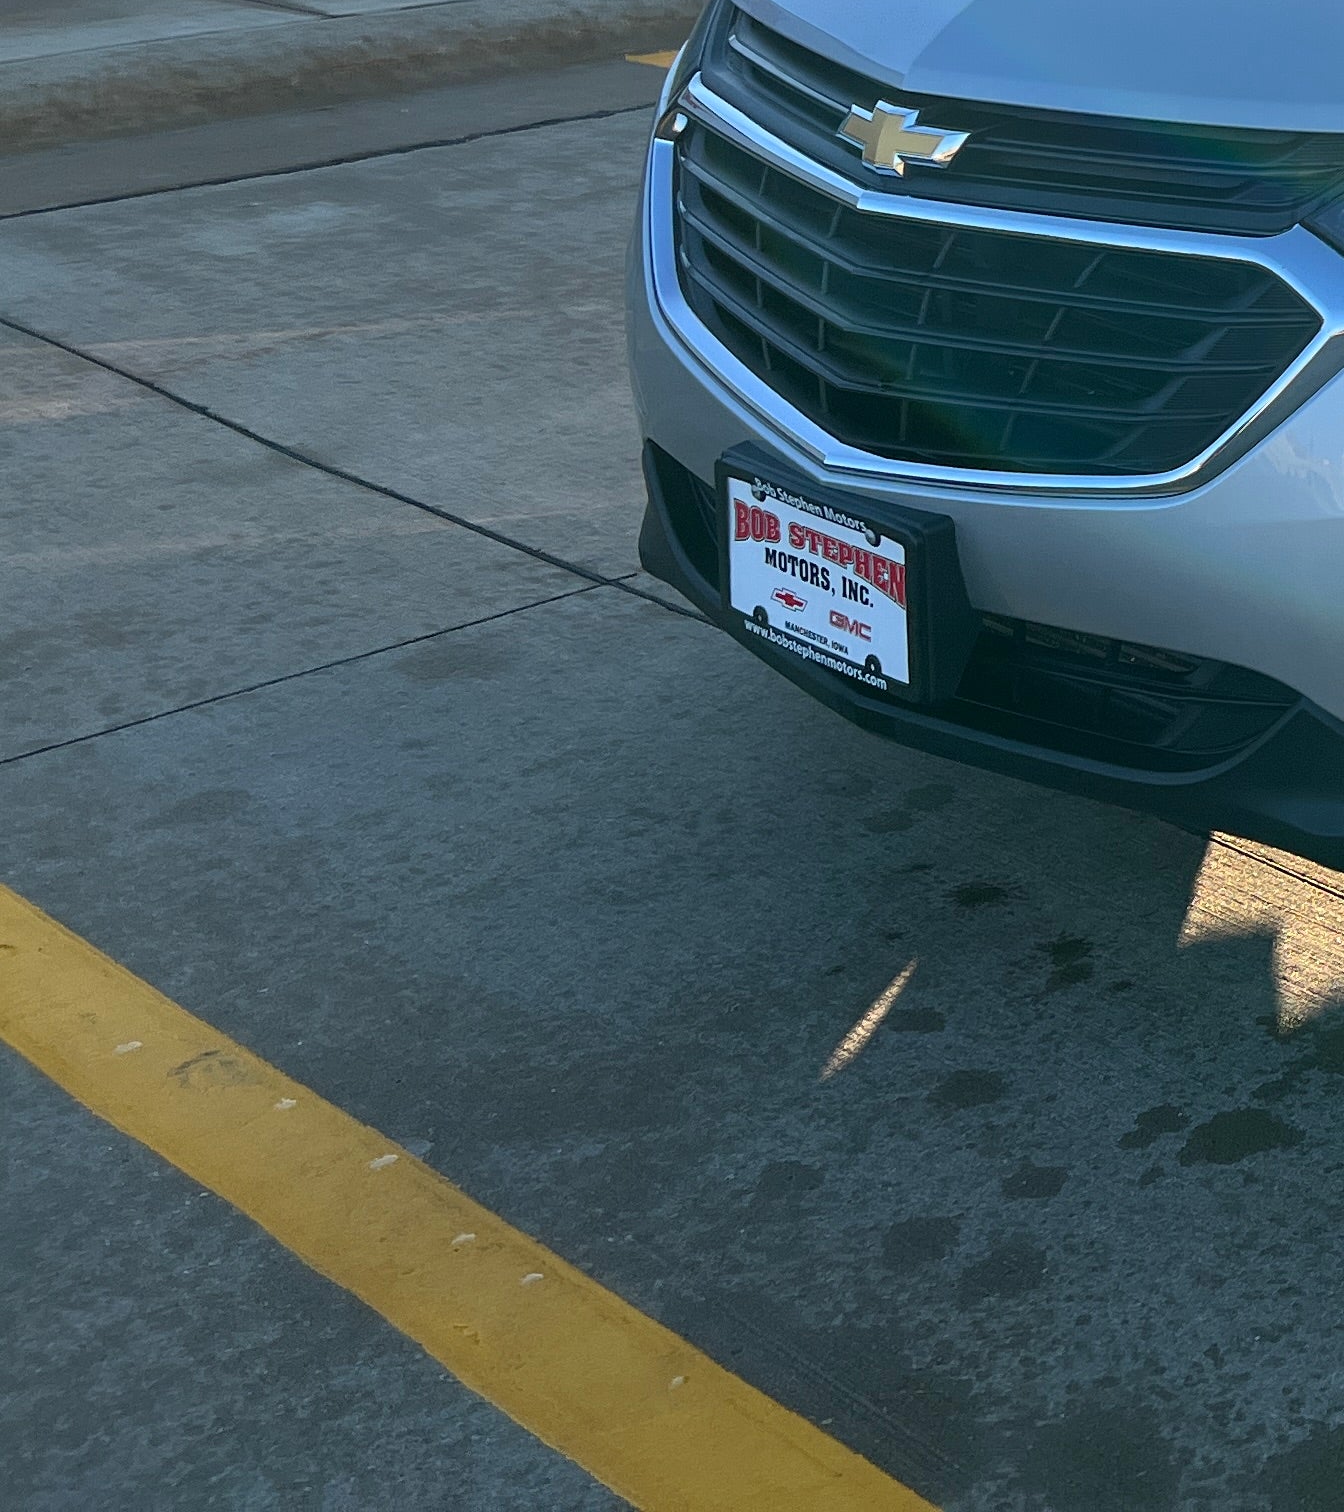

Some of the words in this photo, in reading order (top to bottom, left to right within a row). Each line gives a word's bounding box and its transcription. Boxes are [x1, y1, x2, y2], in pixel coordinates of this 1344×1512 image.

[777, 487, 823, 517] Stephen
[823, 505, 867, 533] Motors
[734, 498, 781, 542] BOB
[788, 521, 906, 610] STEPHEN
[765, 547, 837, 597] MOTORS,
[842, 575, 874, 608] INC.
[785, 620, 830, 648] MANCHESTER,
[831, 640, 849, 656] IOWA
[829, 610, 872, 643] GMC
[743, 619, 888, 691] www.bobstephenmotors.com
